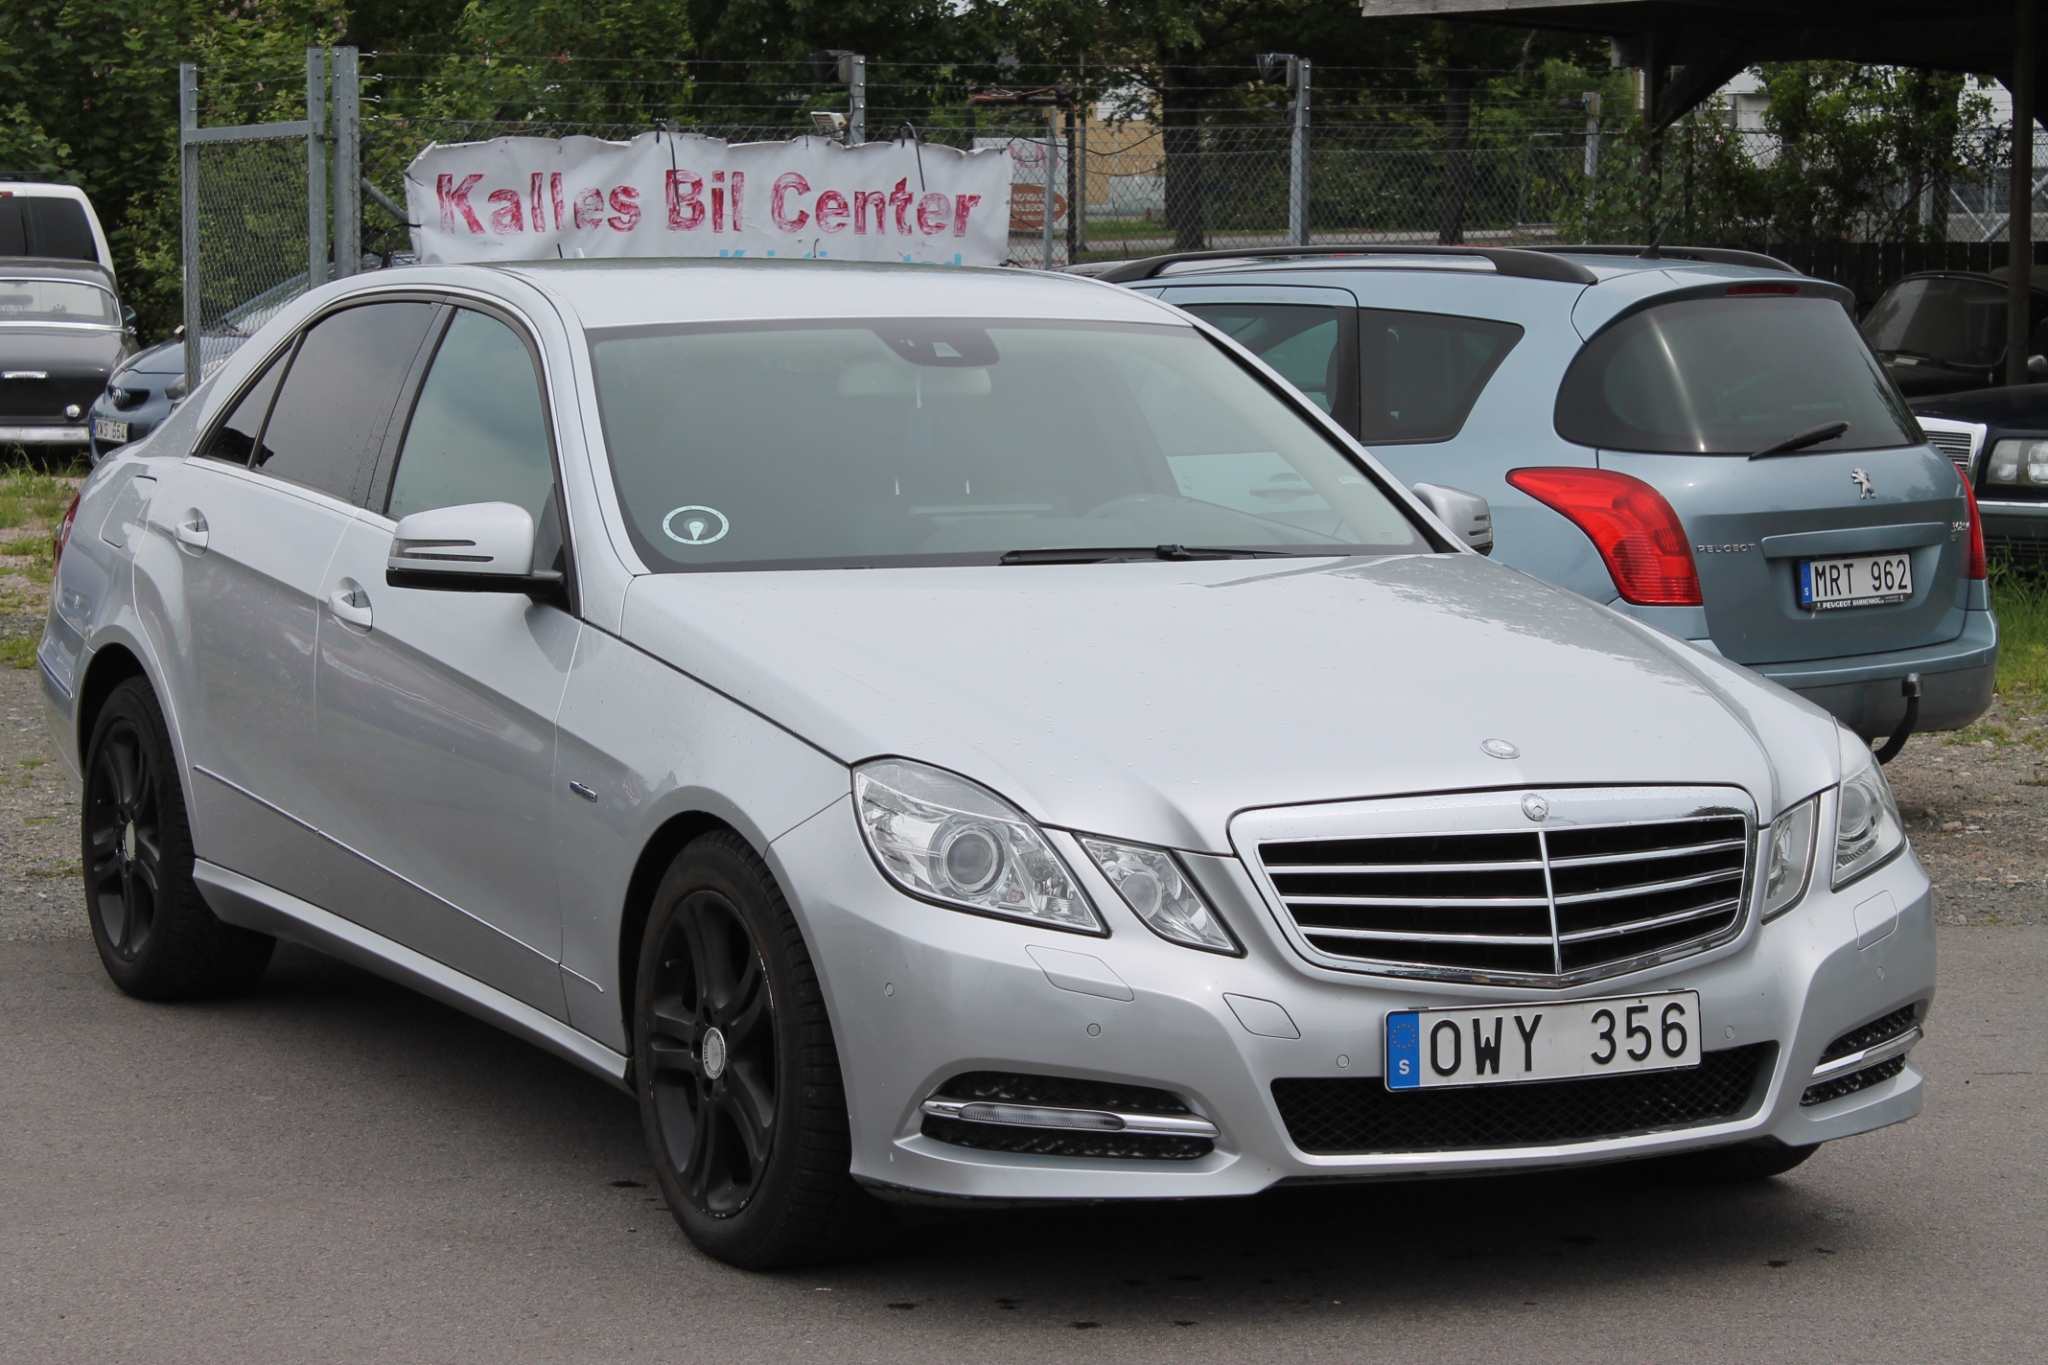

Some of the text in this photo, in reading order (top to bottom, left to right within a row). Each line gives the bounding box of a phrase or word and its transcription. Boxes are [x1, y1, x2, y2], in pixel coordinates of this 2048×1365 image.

[436, 169, 983, 237] Kalles Bil Center
[112, 421, 126, 440] 654
[1696, 543, 1756, 554] PEUGEOT
[1814, 563, 1854, 597] MRT
[1871, 559, 1908, 592] 962
[1822, 600, 1851, 609] PEUGEOT
[1398, 1002, 1688, 1077] S OWY 356
